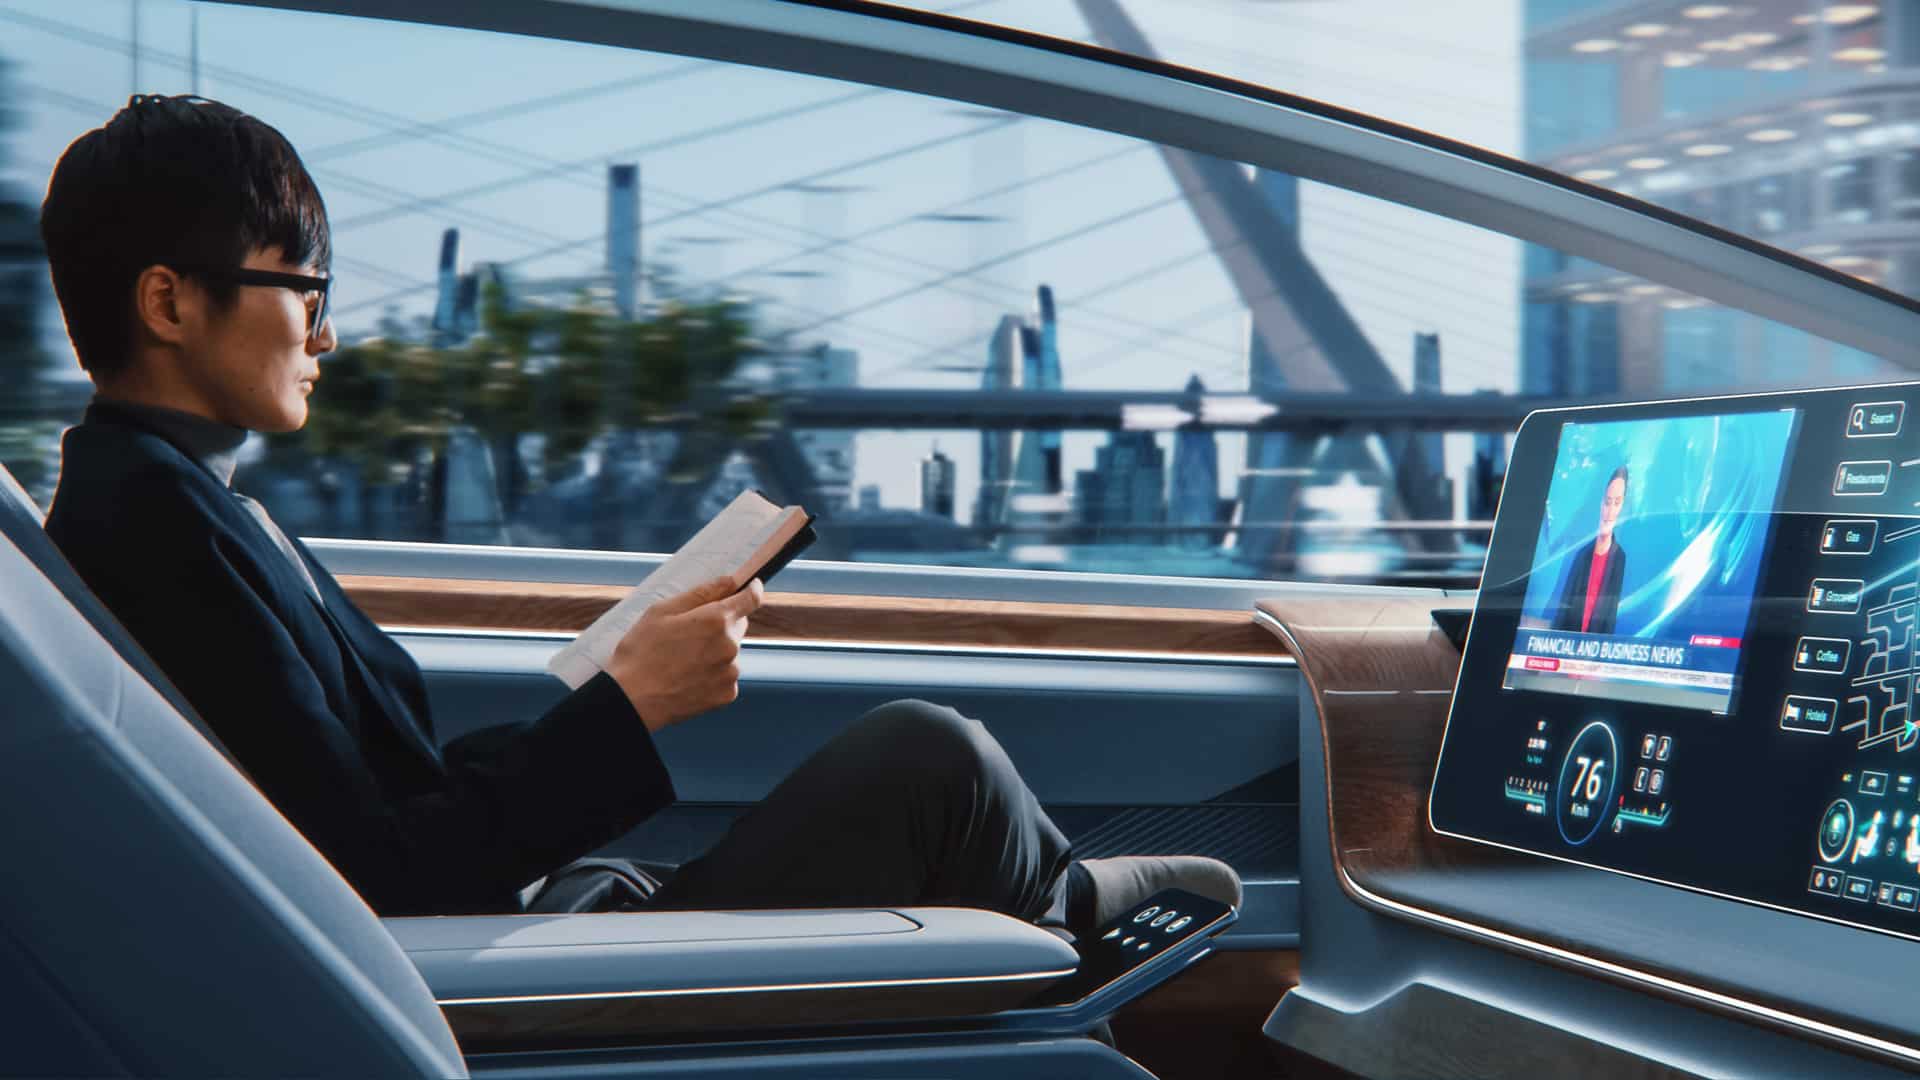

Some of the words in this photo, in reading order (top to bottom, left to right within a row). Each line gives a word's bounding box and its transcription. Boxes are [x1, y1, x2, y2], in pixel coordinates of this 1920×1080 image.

[1870, 413, 1894, 424] Search
[1846, 531, 1860, 543] Gas
[1527, 636, 1575, 656] FINANCIAL
[1576, 641, 1600, 658] AND
[1600, 642, 1650, 662] BUSINESS
[1651, 646, 1684, 665] NEWS
[1816, 649, 1839, 663] Coffee
[1805, 708, 1828, 722] Hotels
[1571, 756, 1605, 801] 76
